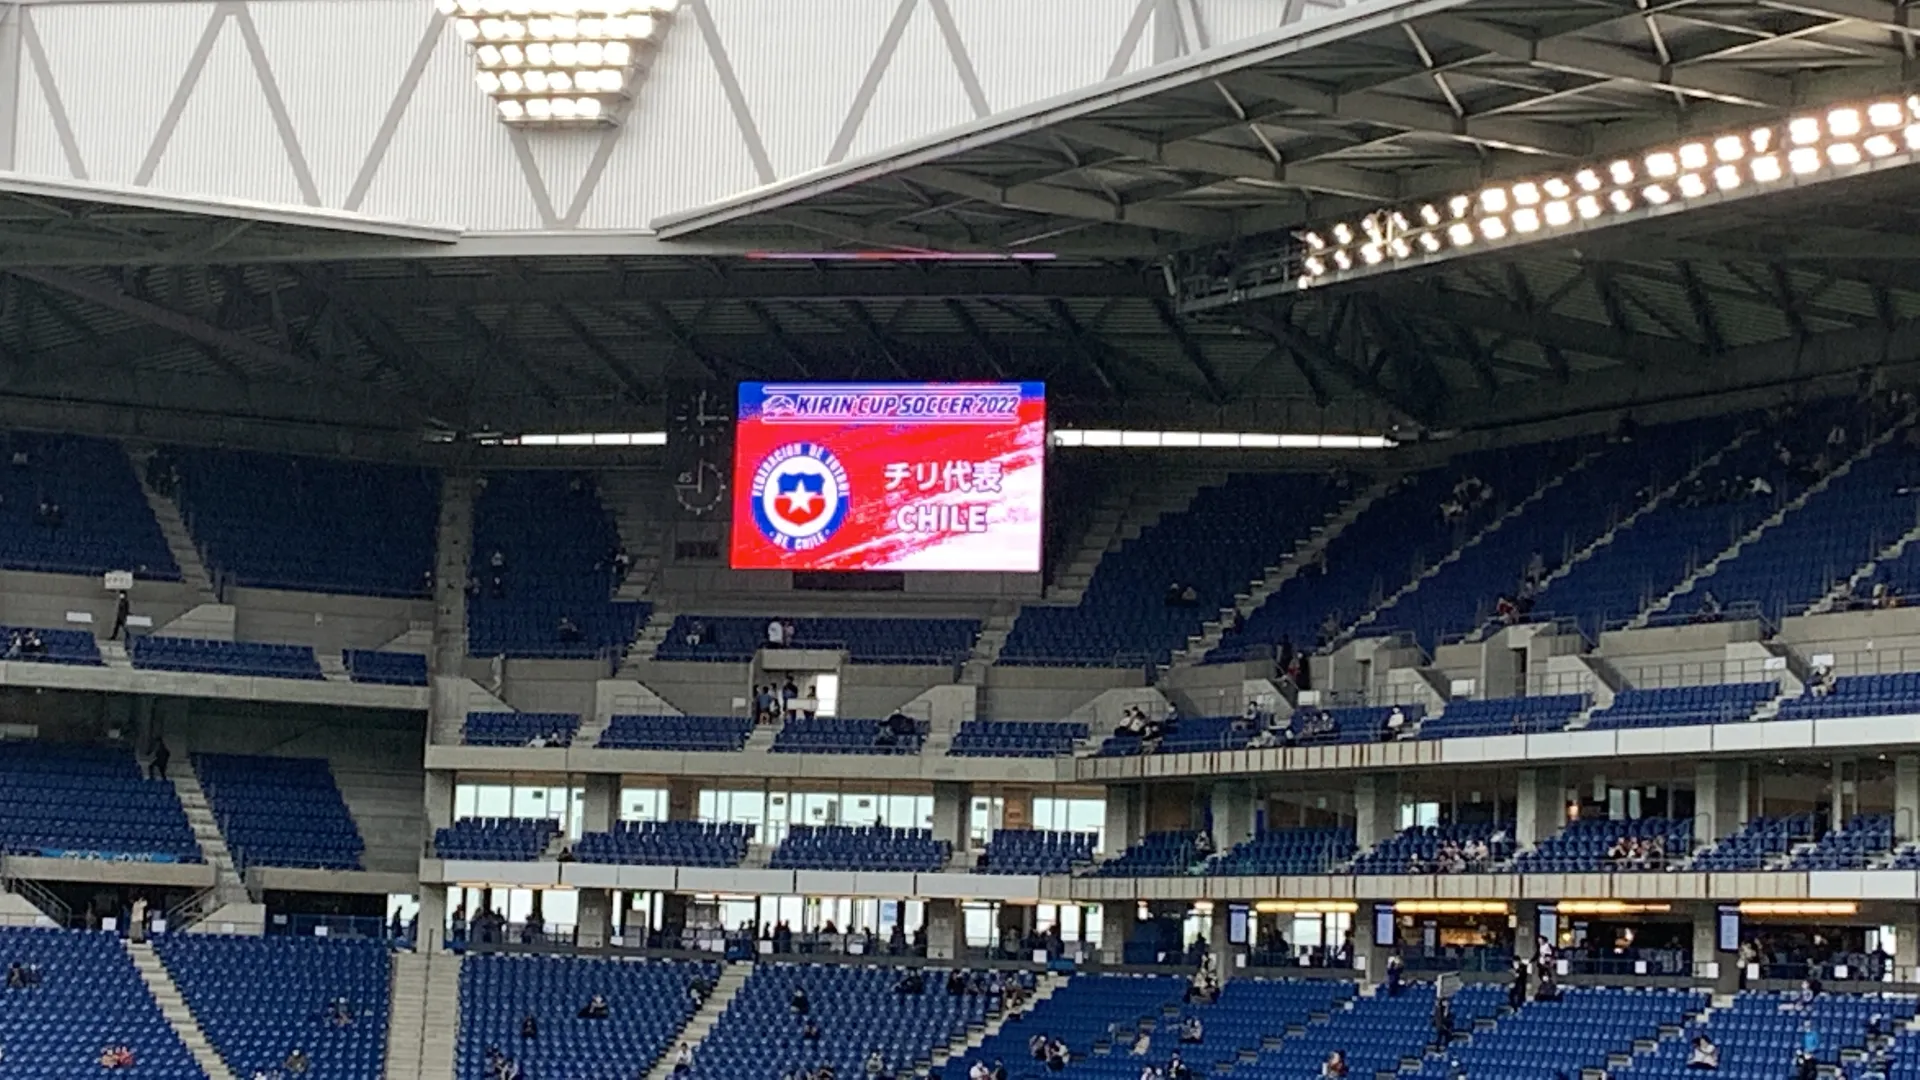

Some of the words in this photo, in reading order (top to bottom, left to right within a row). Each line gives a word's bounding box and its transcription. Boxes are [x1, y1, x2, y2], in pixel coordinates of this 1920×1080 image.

[797, 396, 854, 414] KIRIN
[858, 396, 897, 414] CUP
[900, 396, 974, 414] SOCCER
[976, 396, 1019, 413] 2022
[809, 443, 826, 461] DE
[884, 460, 1002, 493] チリ代表
[896, 504, 988, 533] CHILE
[773, 531, 790, 549] DE
